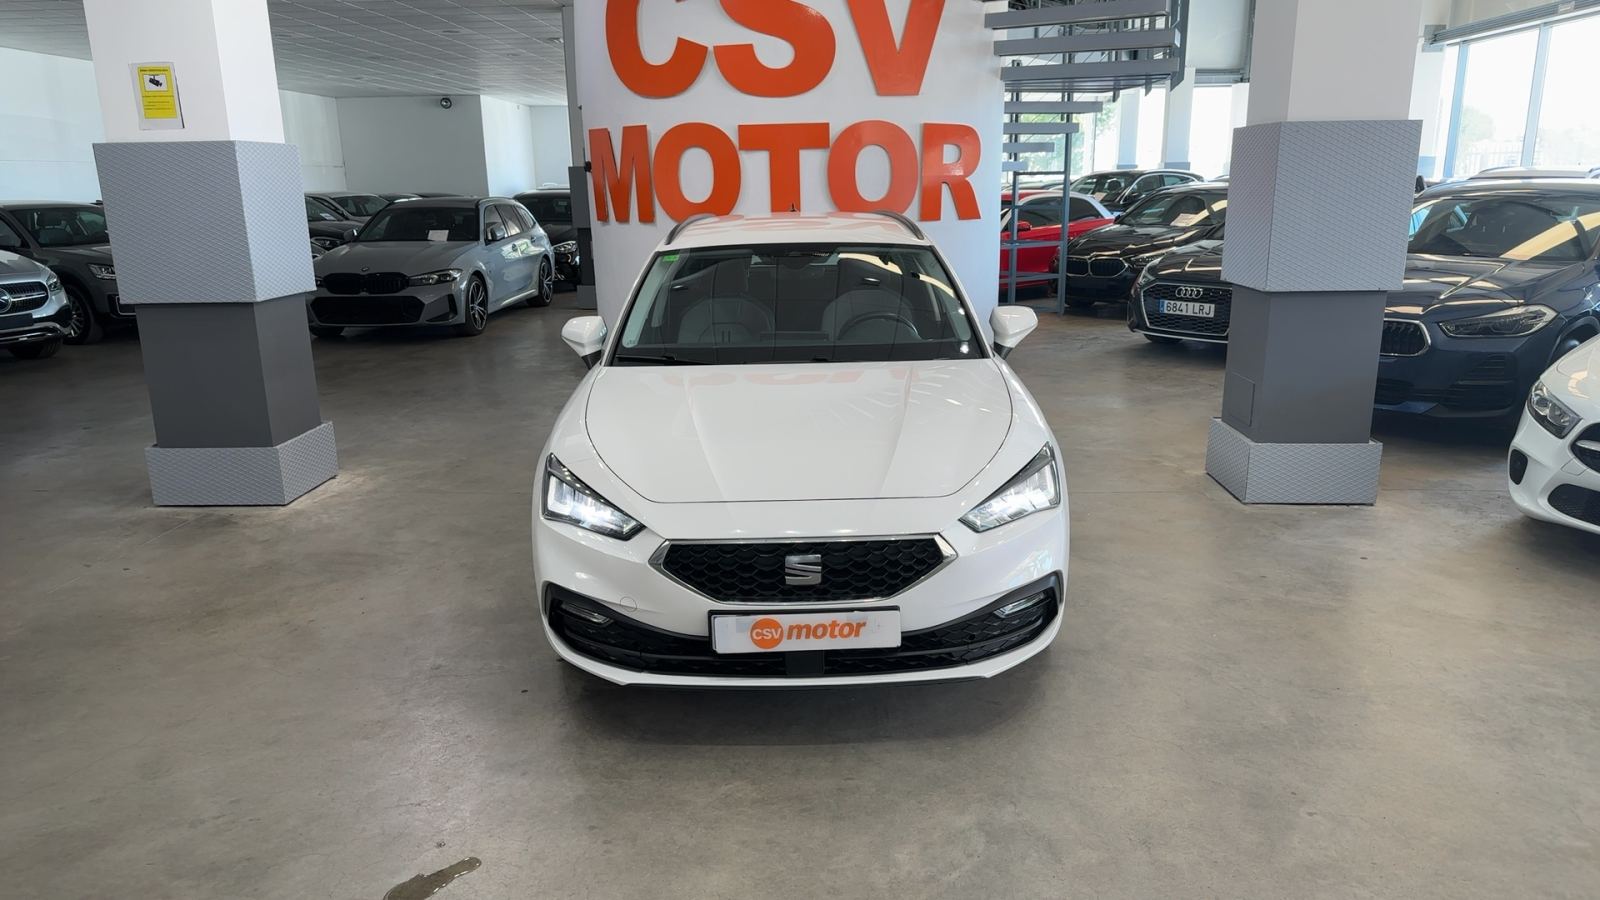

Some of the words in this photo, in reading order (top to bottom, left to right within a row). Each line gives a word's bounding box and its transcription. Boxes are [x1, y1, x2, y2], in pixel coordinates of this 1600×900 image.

[605, 0, 946, 98] CSV
[588, 120, 981, 223] MOTOR
[1166, 302, 1188, 313] 6841
[1192, 304, 1211, 315] LRJ
[752, 628, 782, 640] CSV
[786, 620, 866, 640] motor
